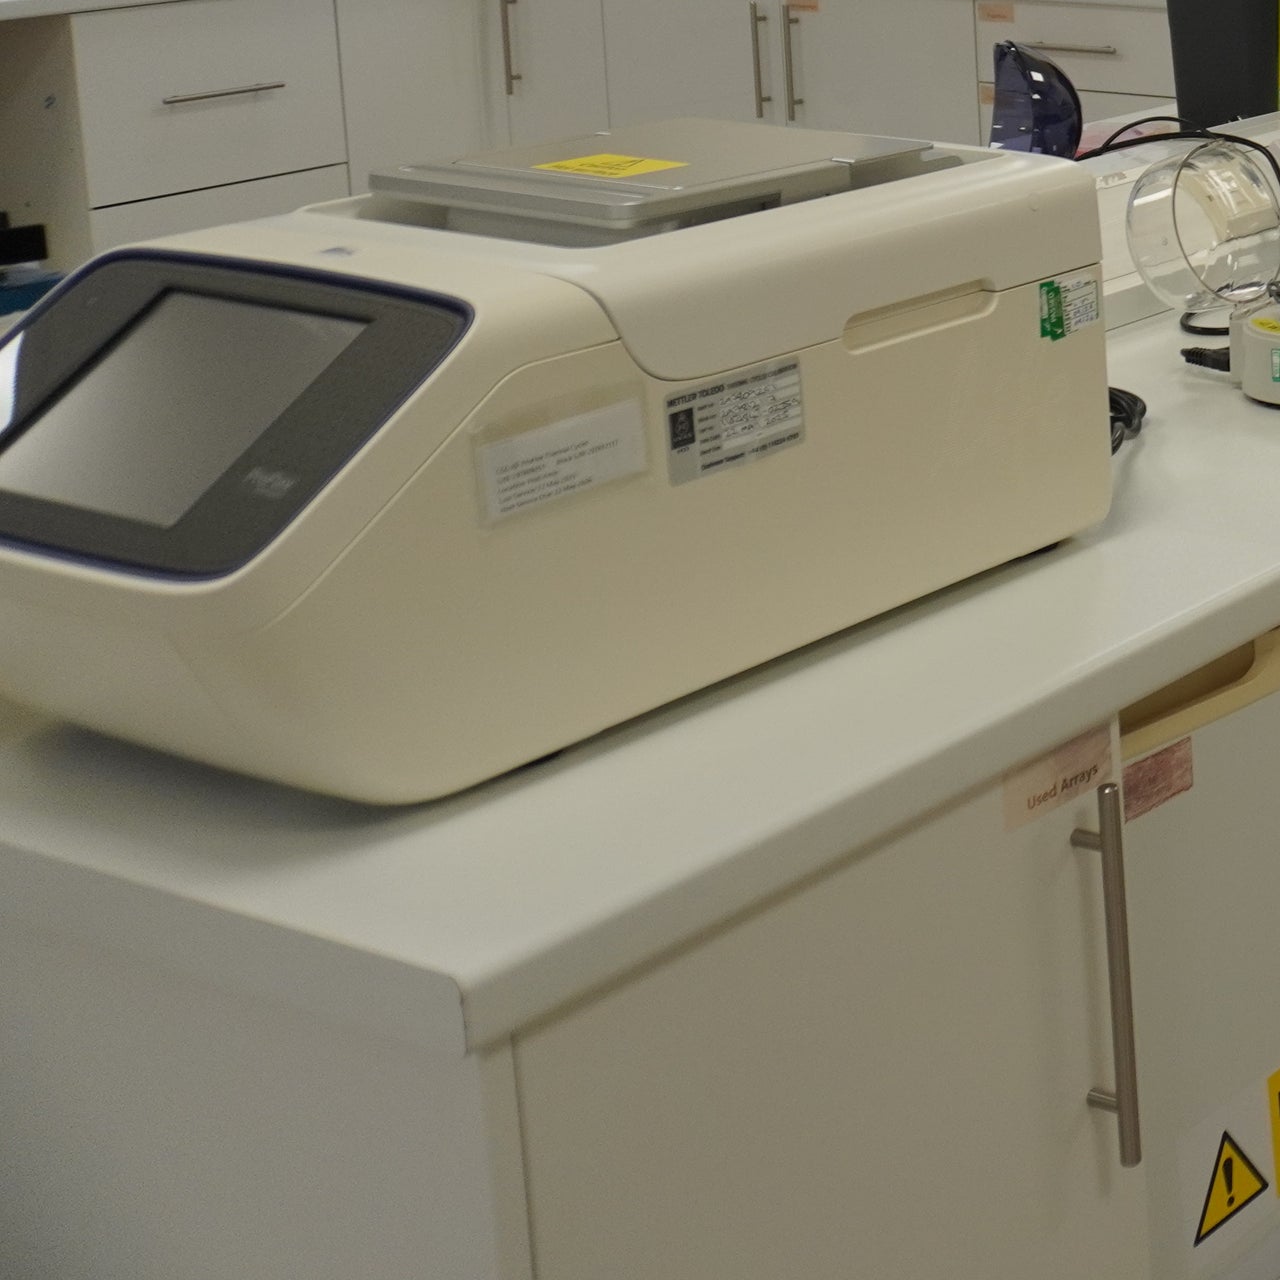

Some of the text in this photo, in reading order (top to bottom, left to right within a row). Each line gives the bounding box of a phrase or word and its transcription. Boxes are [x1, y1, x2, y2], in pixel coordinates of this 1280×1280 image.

[666, 393, 697, 408] METTLER
[698, 384, 725, 400] TOLEDO
[1027, 763, 1098, 810] Used Arrays
